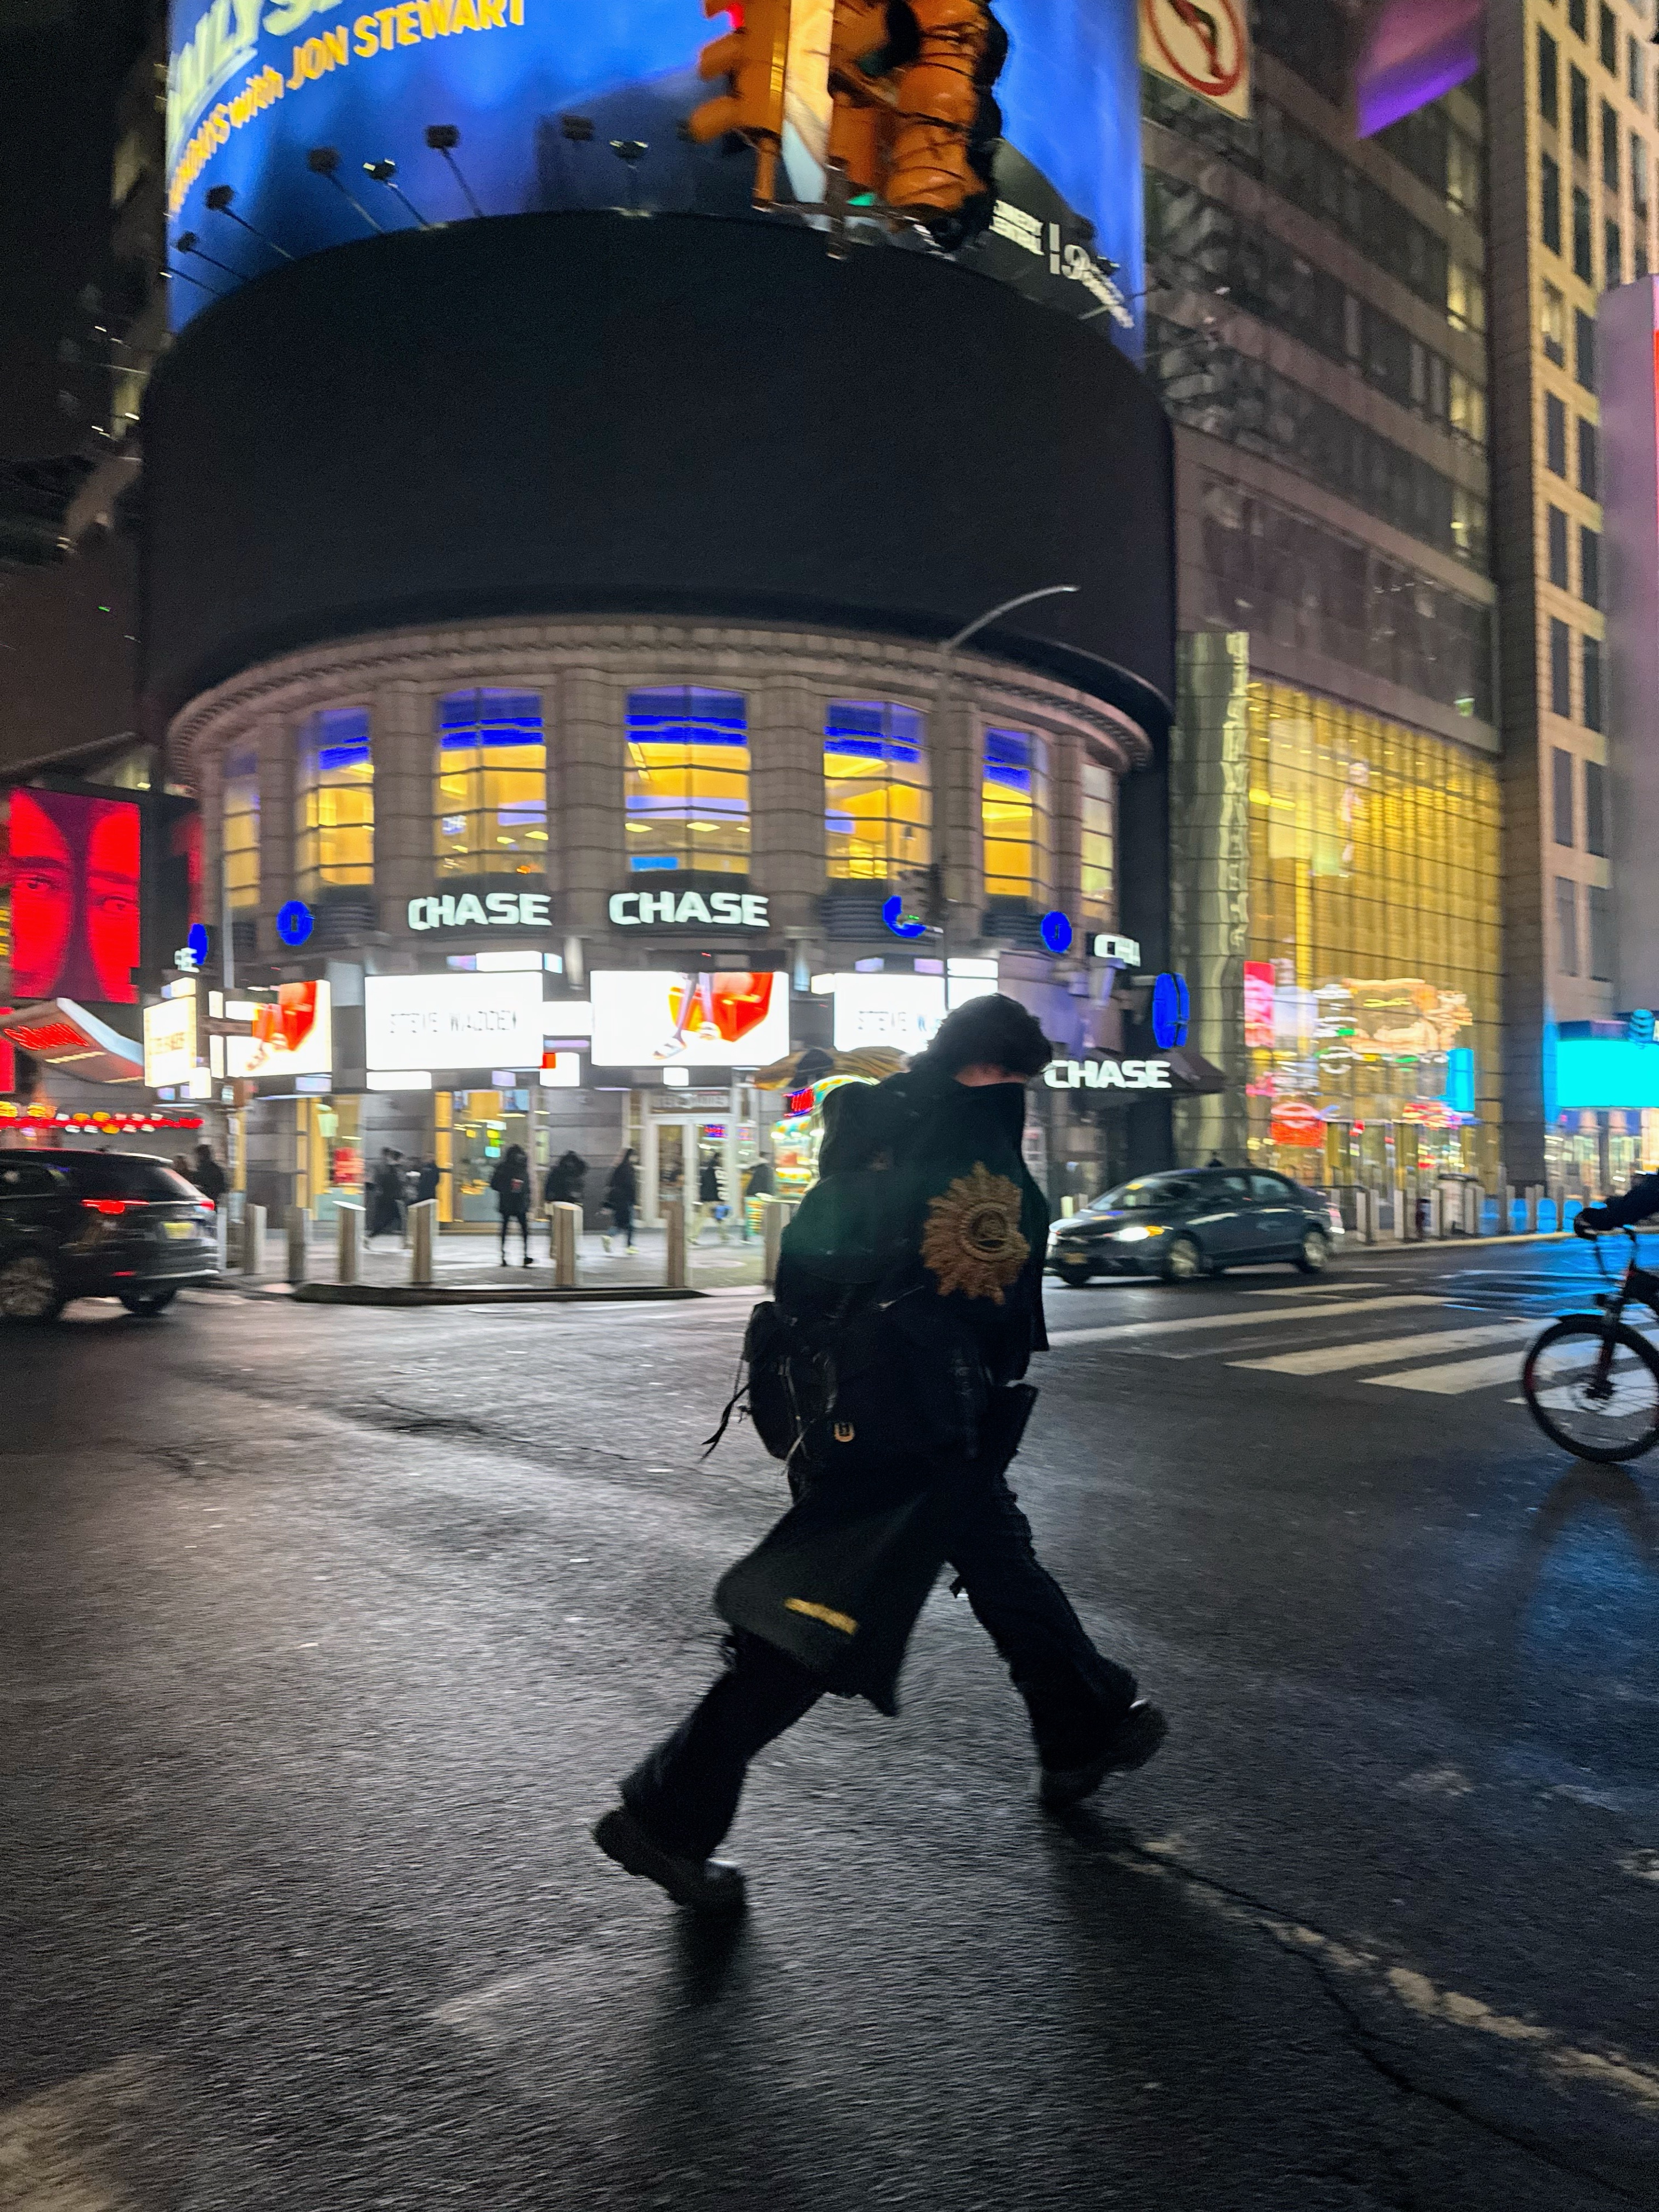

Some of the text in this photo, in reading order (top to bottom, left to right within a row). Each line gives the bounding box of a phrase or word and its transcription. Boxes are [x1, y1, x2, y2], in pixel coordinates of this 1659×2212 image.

[286, 25, 349, 90] JON
[408, 893, 552, 930] CHASE
[609, 891, 770, 927] CHASE
[1042, 1060, 1172, 1088] CHASE
